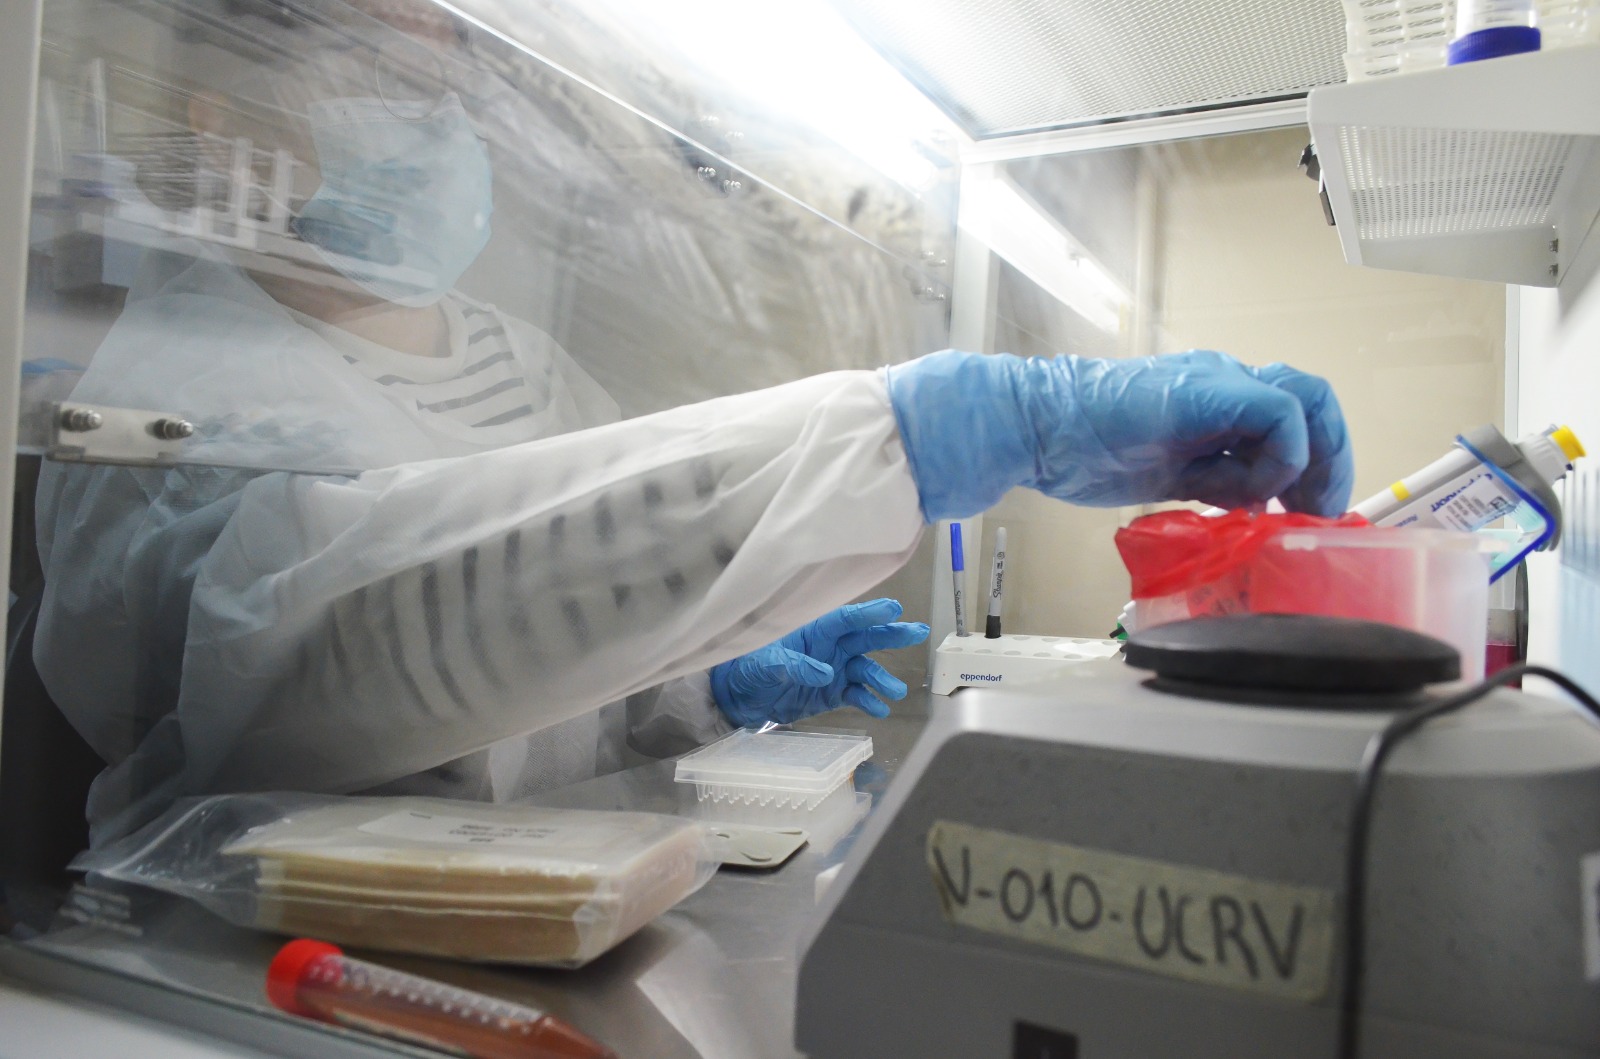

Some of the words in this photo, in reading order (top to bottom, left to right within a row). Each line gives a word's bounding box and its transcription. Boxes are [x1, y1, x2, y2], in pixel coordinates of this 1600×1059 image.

[993, 571, 1003, 598] Sharpie
[960, 673, 1002, 682] eppendorf
[932, 846, 1305, 981] V-010-UCRV
